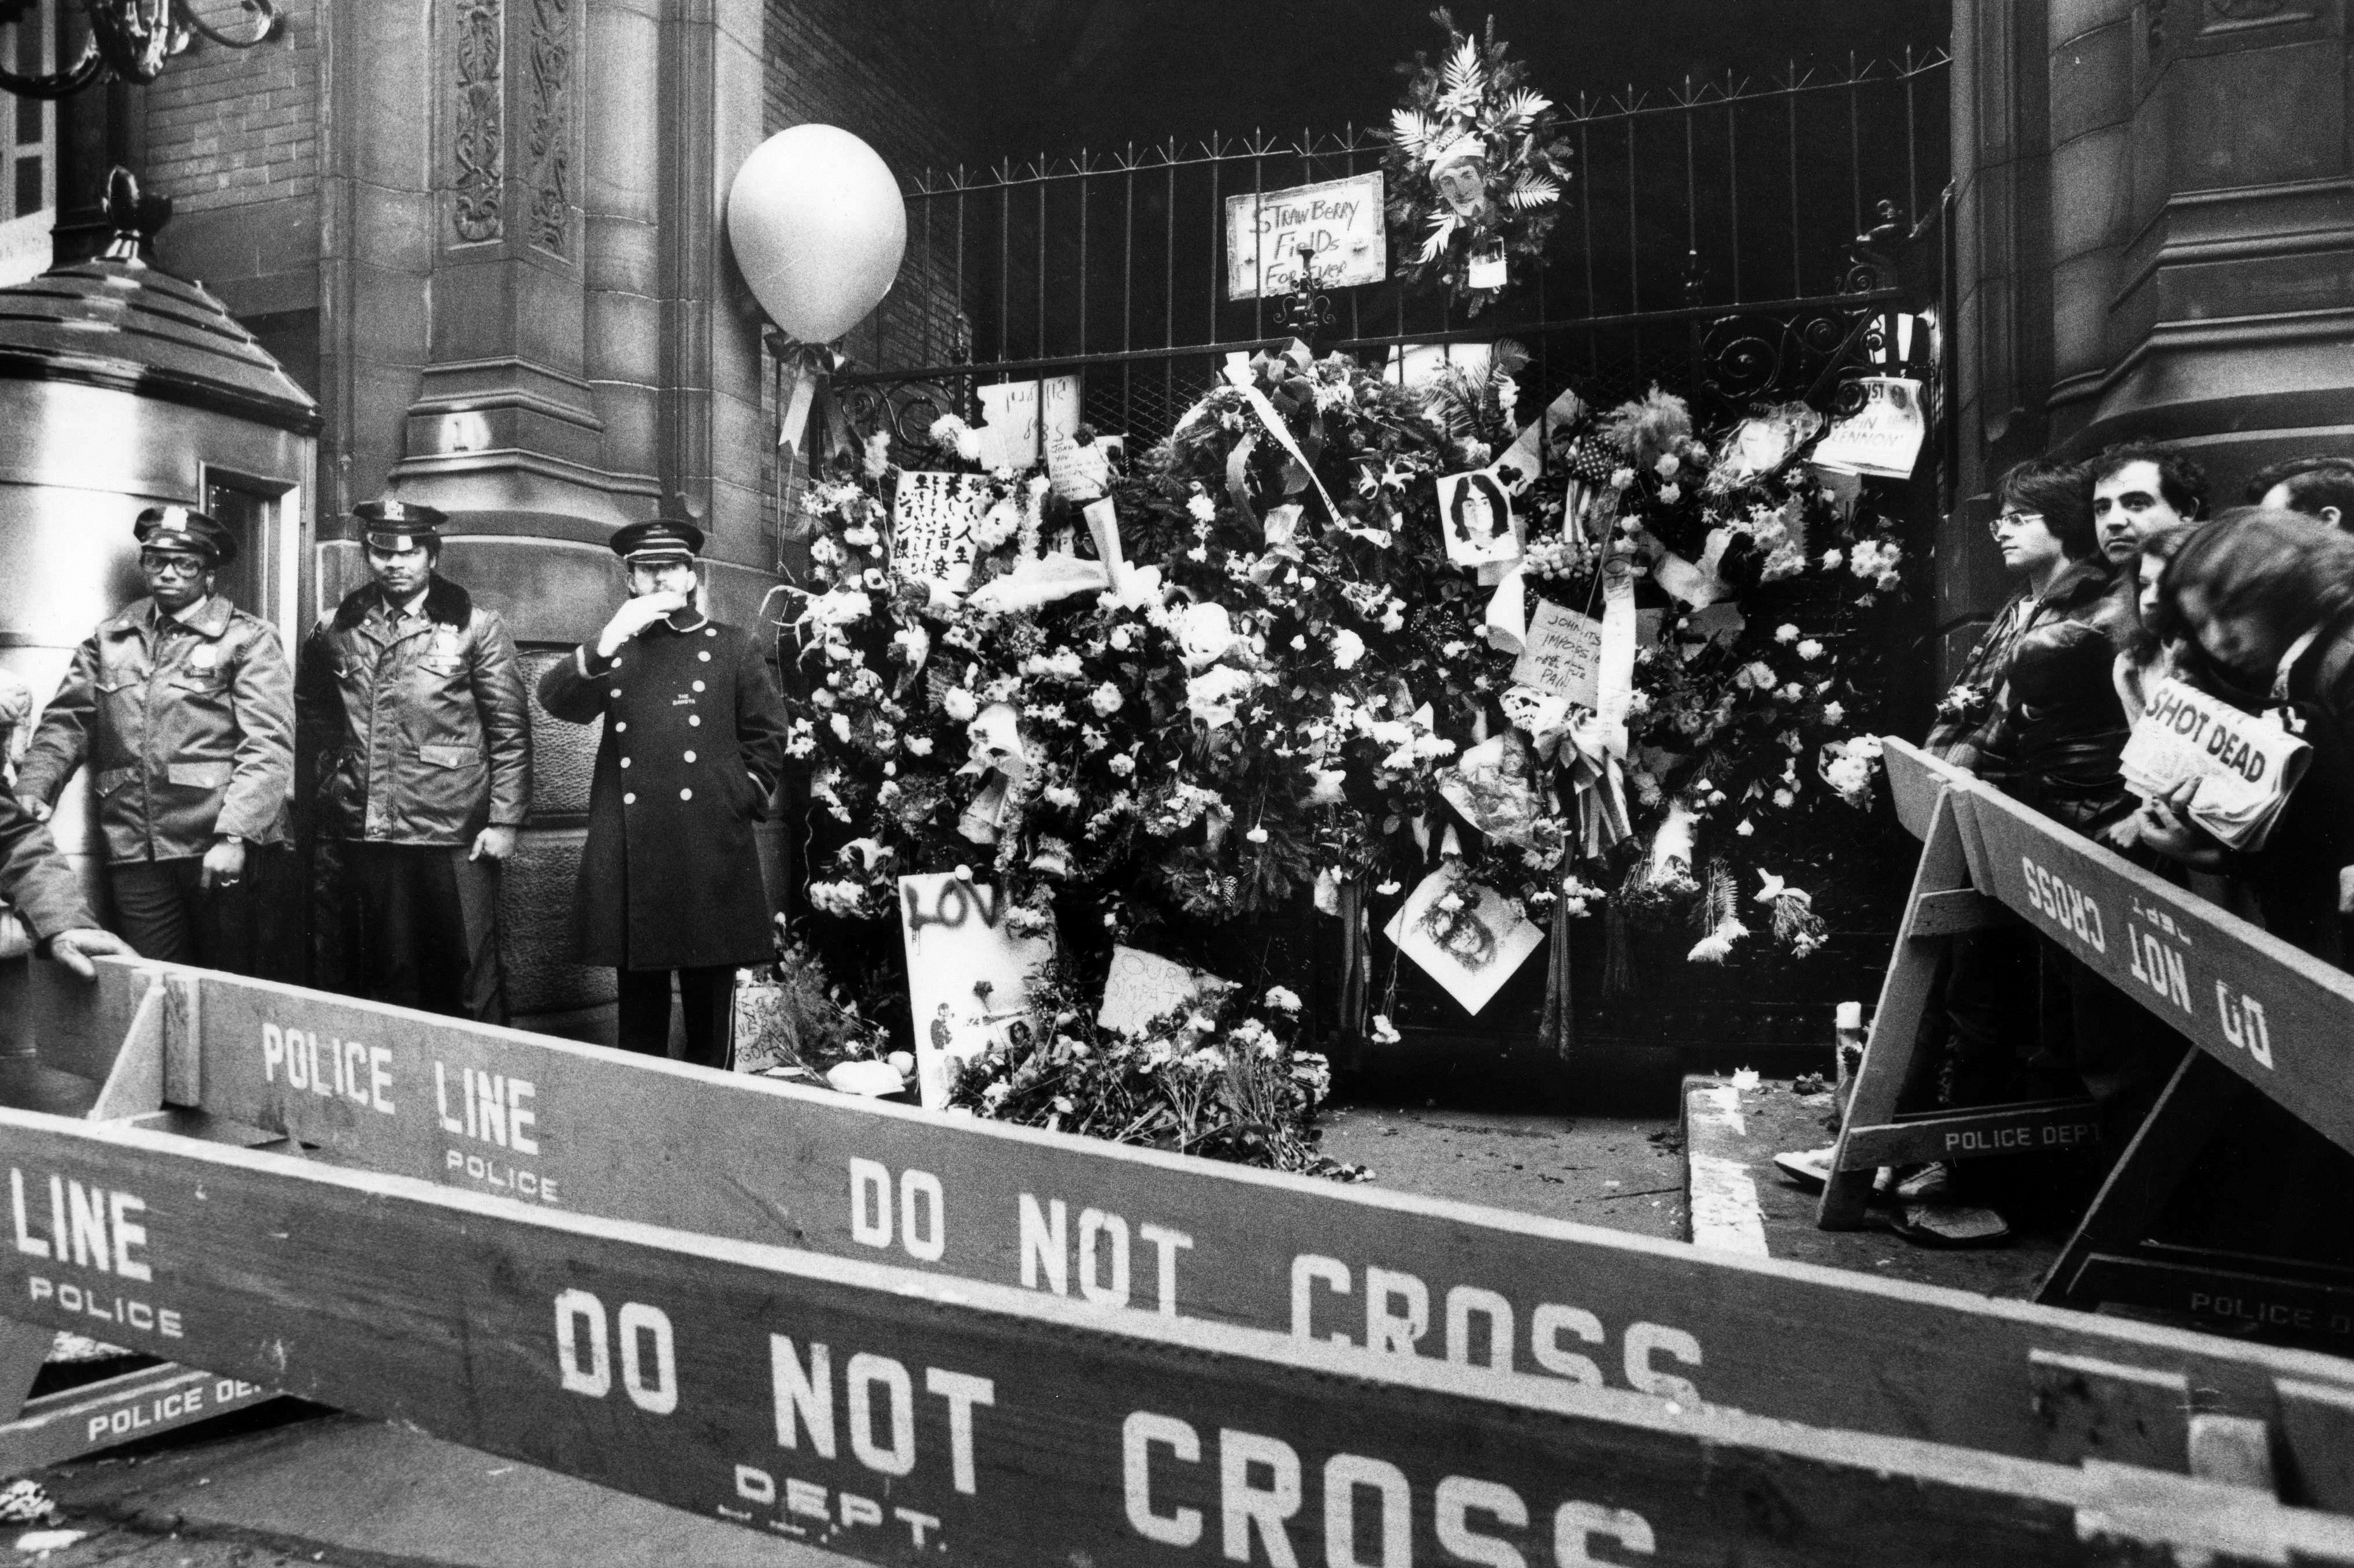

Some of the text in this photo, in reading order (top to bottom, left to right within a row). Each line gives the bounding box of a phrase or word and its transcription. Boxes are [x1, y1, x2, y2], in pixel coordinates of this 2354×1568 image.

[2145, 688, 2211, 743] SHOT
[2206, 724, 2266, 783] DEAD
[2022, 856, 2106, 954] CROSS
[2129, 923, 2192, 1015] NOT
[447, 1150, 558, 1202] POLICE
[1945, 1127, 2032, 1151] POLICE
[262, 1022, 1702, 1403] POLICE LINE DO NOT CROSS
[10, 1167, 152, 1282] LINE
[555, 1288, 678, 1415] DO
[770, 1332, 996, 1495] NOT
[29, 1276, 184, 1337] POLICE
[2191, 1292, 2312, 1329] POLICE
[88, 1378, 261, 1441] POLICE DE
[734, 1464, 947, 1552] DEPT.
